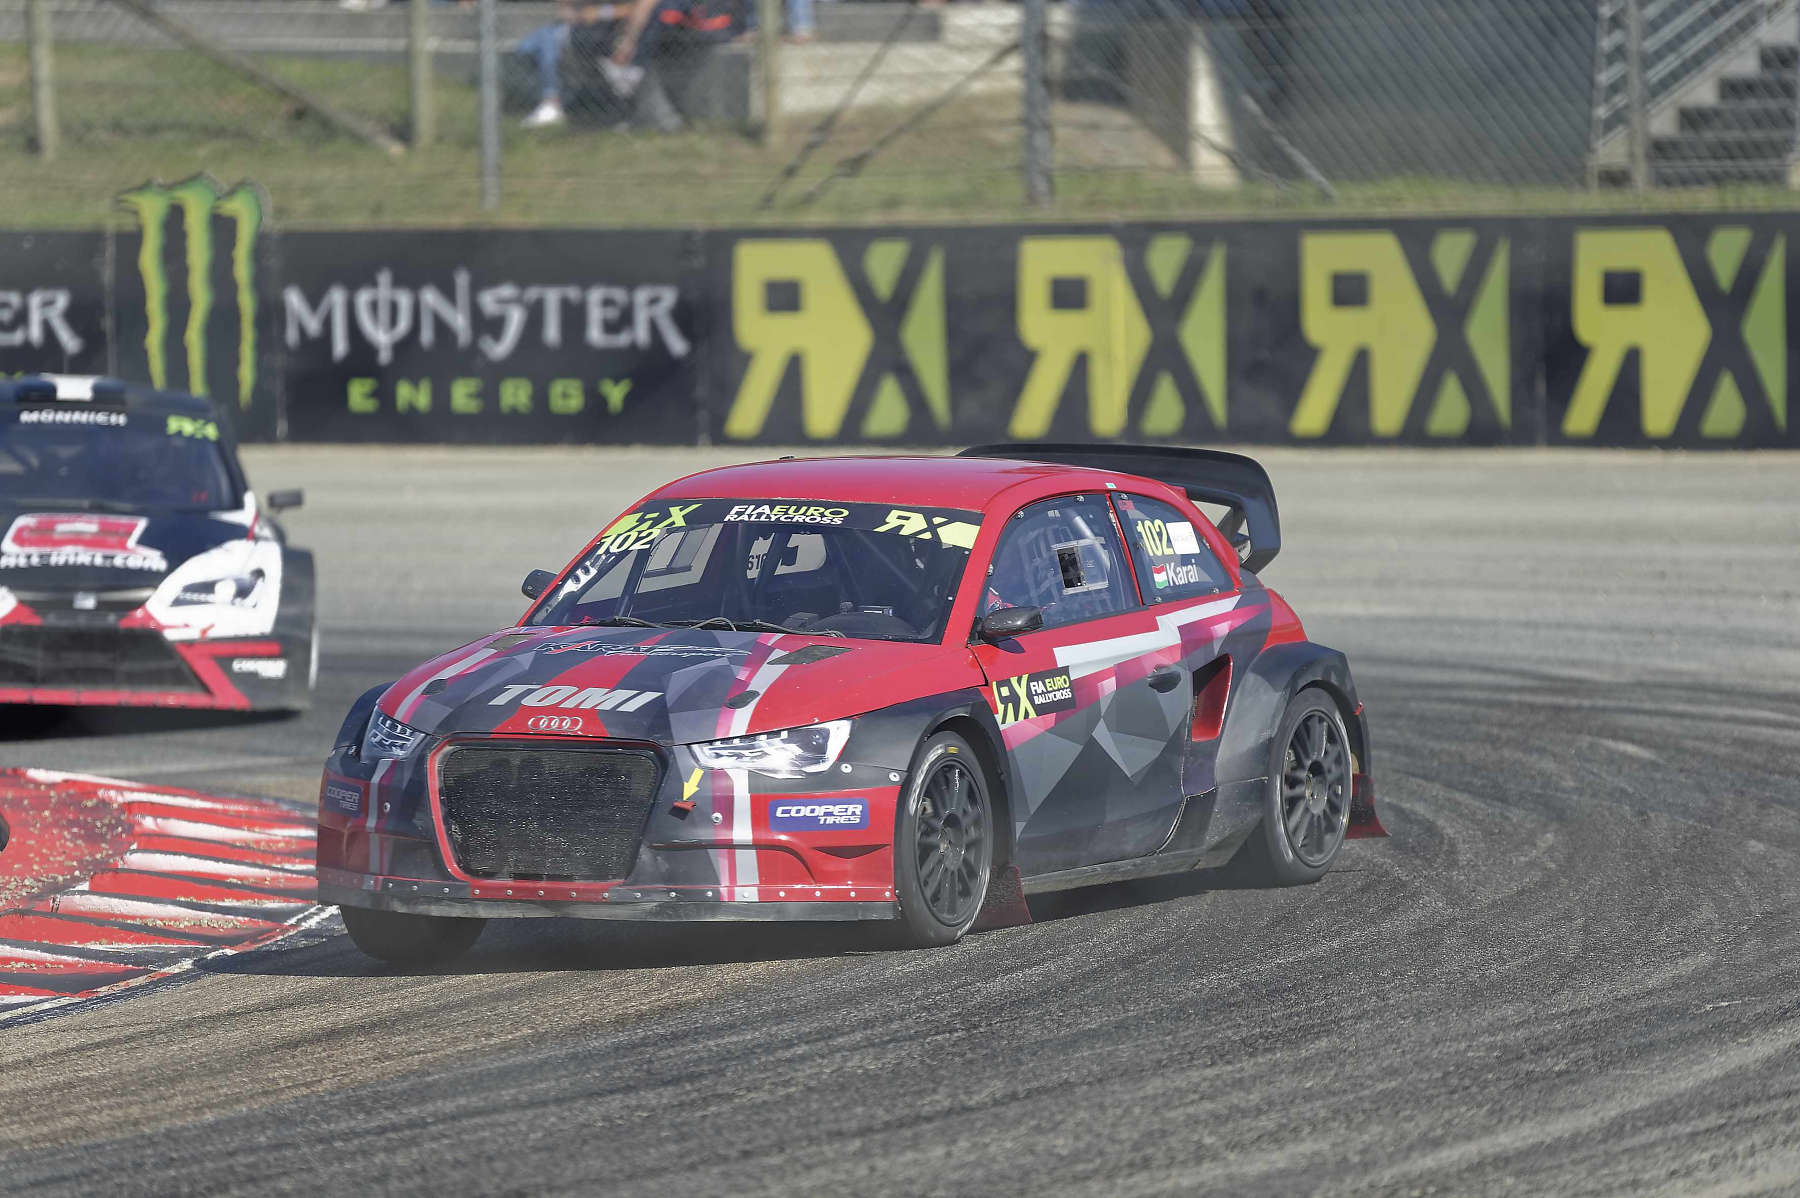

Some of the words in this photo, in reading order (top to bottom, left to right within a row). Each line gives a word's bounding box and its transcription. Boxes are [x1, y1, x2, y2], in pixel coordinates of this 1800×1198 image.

[284, 267, 692, 367] MONSTER
[347, 376, 633, 414] ENERGY
[723, 513, 845, 525] RALLYCROSS
[596, 528, 662, 555] 102
[1136, 519, 1175, 557] 102
[1165, 558, 1200, 587] Karai
[487, 684, 665, 713] TOMI
[1029, 680, 1047, 695] FIA
[1044, 675, 1071, 691] EURO
[1033, 688, 1072, 705] RALLYCROSS
[775, 804, 863, 818] COOPER
[817, 815, 862, 825] TIRES
